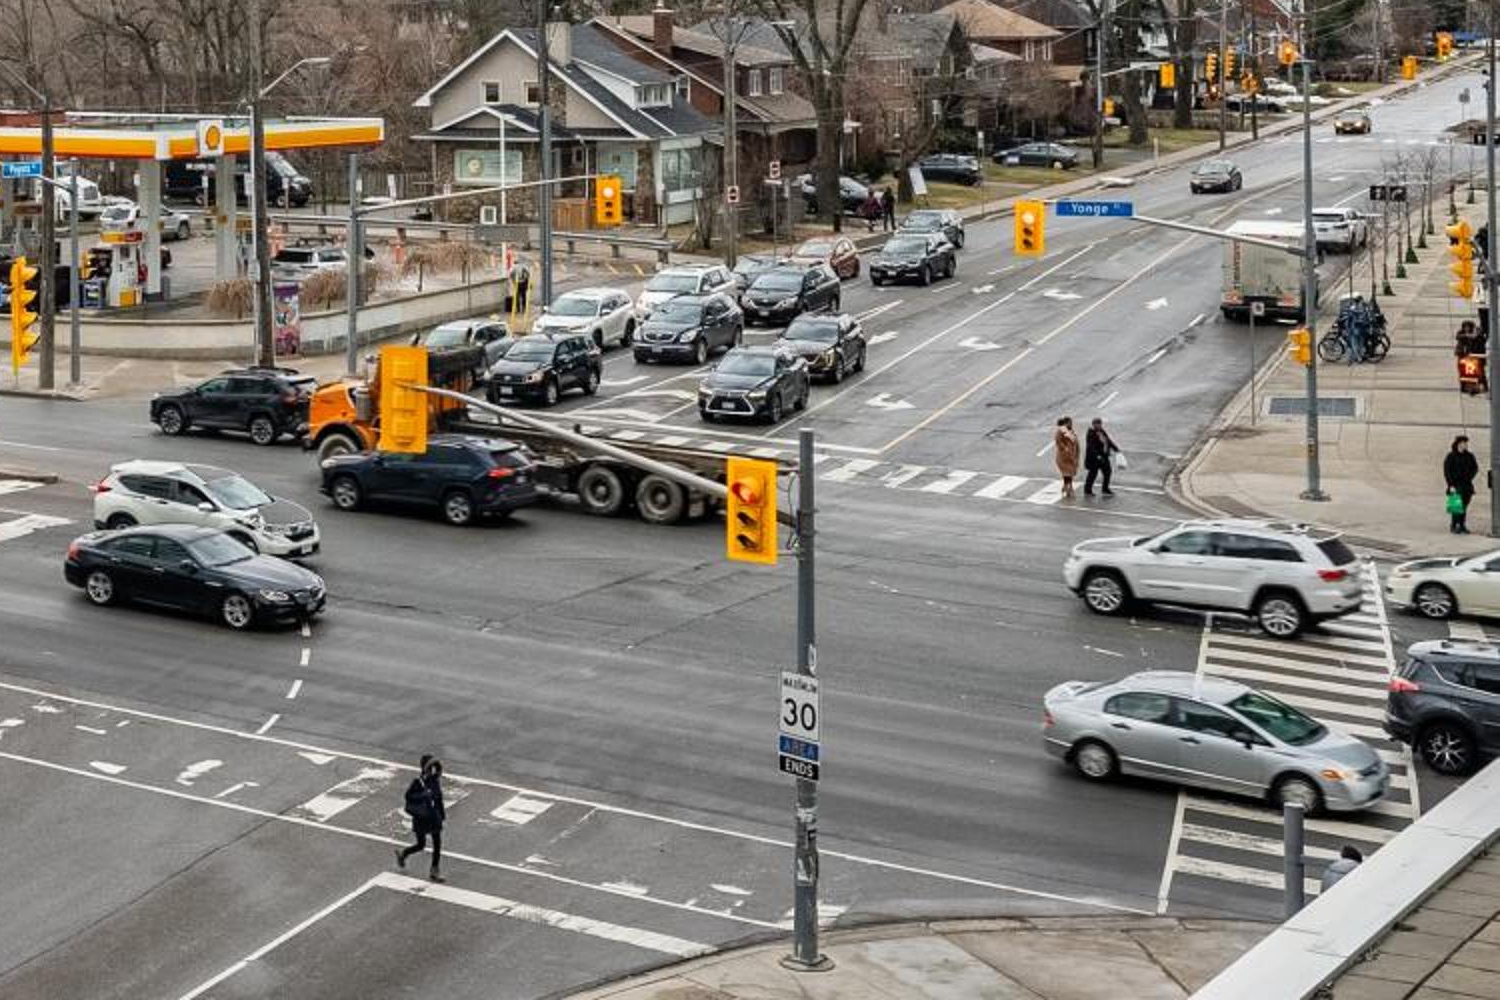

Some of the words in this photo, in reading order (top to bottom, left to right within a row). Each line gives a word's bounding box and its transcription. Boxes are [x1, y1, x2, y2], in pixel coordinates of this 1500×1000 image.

[1071, 203, 1109, 217] Yonge
[783, 698, 816, 731] 30
[785, 757, 813, 777] ENDS
